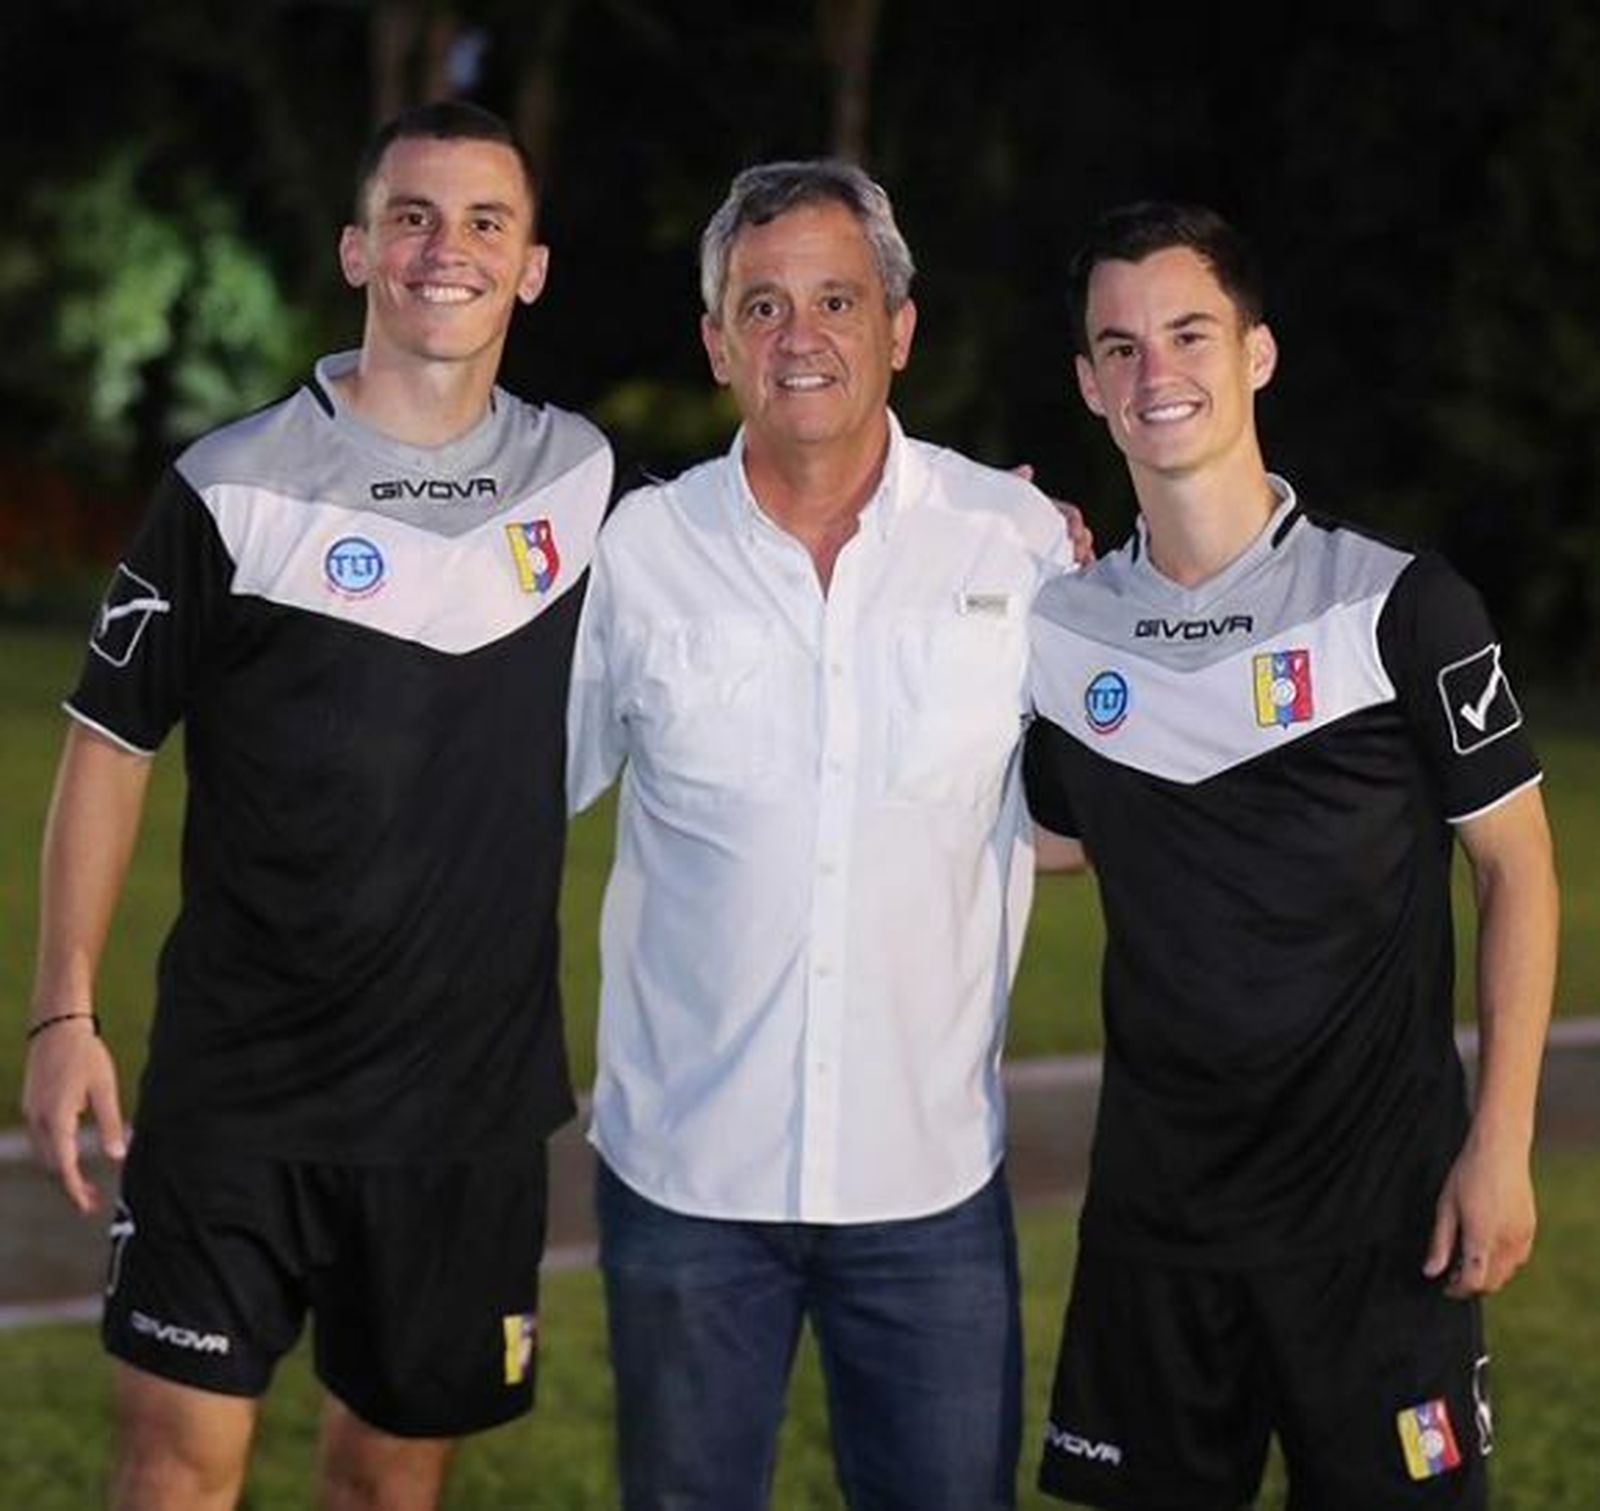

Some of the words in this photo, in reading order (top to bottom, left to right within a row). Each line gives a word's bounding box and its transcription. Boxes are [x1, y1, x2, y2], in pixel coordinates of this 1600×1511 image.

[371, 478, 497, 500] GIVOVA
[330, 555, 378, 577] TLT
[1134, 615, 1254, 640] GIVOVA
[1088, 687, 1124, 711] TLT
